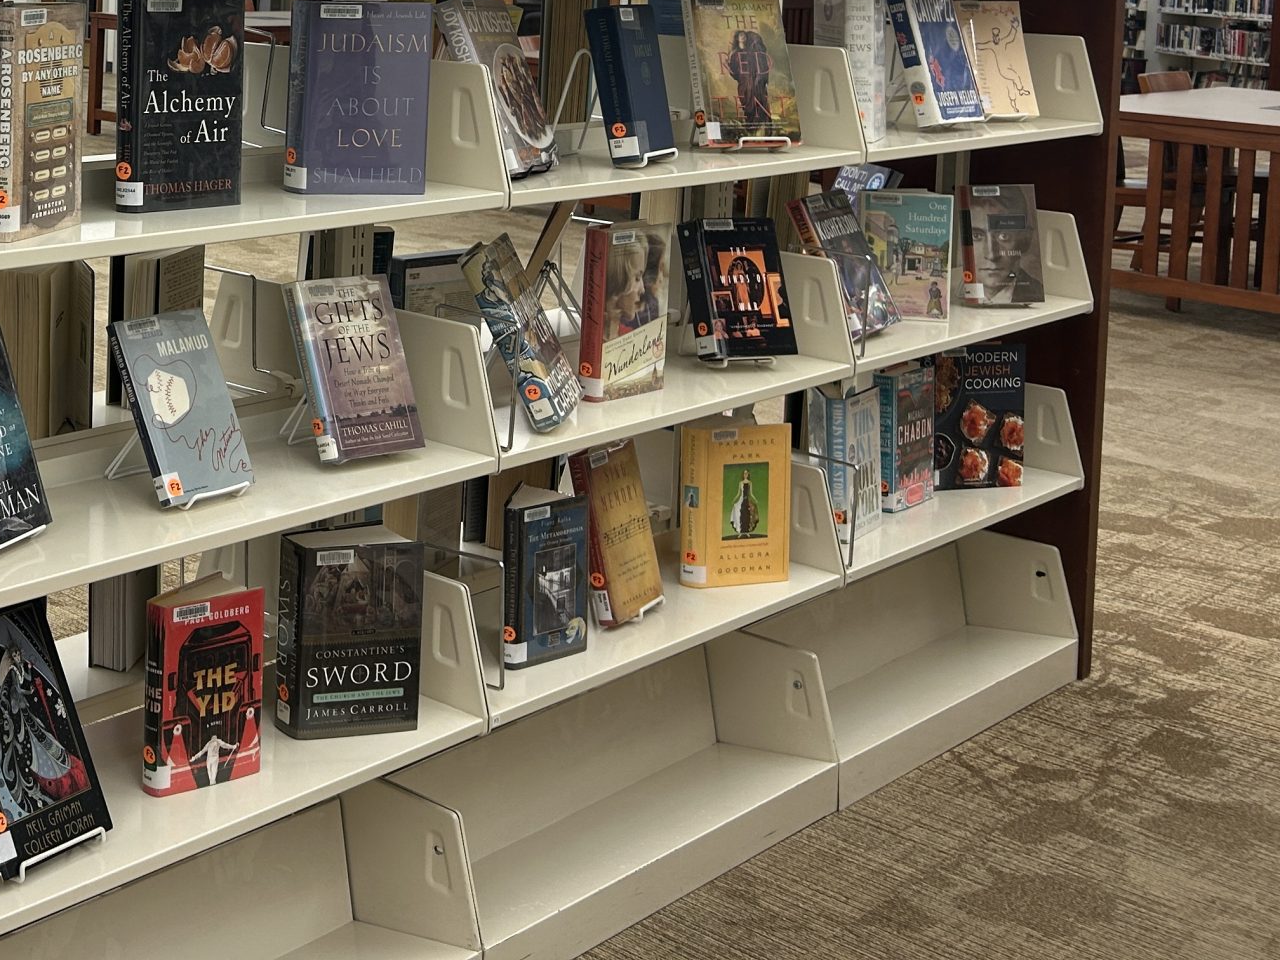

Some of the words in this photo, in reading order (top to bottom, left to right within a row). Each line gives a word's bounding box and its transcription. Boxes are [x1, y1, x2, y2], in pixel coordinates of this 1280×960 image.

[721, 14, 759, 30] THE
[318, 33, 428, 53] JUDAISM
[18, 44, 83, 65] ROSENBERG
[718, 51, 773, 75] RED
[148, 69, 168, 82] The
[363, 66, 382, 86] IS
[41, 85, 61, 95] NAME
[143, 90, 236, 118] Alchemy
[326, 97, 414, 117] ABOUT
[711, 95, 793, 119] TENT
[180, 131, 192, 144] of
[194, 119, 229, 143] Air
[337, 128, 402, 148] LOVE
[144, 182, 192, 196] THOMAS
[194, 179, 232, 191] HAGER
[929, 202, 947, 211] One
[908, 214, 947, 223] Hundred
[905, 224, 946, 236] Saturdays
[337, 288, 355, 298] THE
[314, 297, 384, 325] GIFTS
[156, 334, 209, 357] MALAMUD
[323, 332, 391, 371] JEWS
[965, 352, 1018, 363] MODERN
[965, 365, 1010, 376] JEWISH
[965, 377, 1021, 390] COOKING
[342, 423, 377, 437] THOMAS
[378, 419, 408, 432] CAHILL
[315, 645, 405, 659] CONSTANTINE'S
[194, 661, 237, 691] THE
[305, 660, 412, 689] SWORD
[195, 690, 237, 718] YID
[305, 706, 346, 720] JAMES
[350, 701, 409, 715] CARROLL
[26, 820, 47, 838] NEIL
[48, 800, 82, 826] GAIMAN
[24, 832, 62, 856] COLLEEN
[66, 813, 96, 839] DORAN
